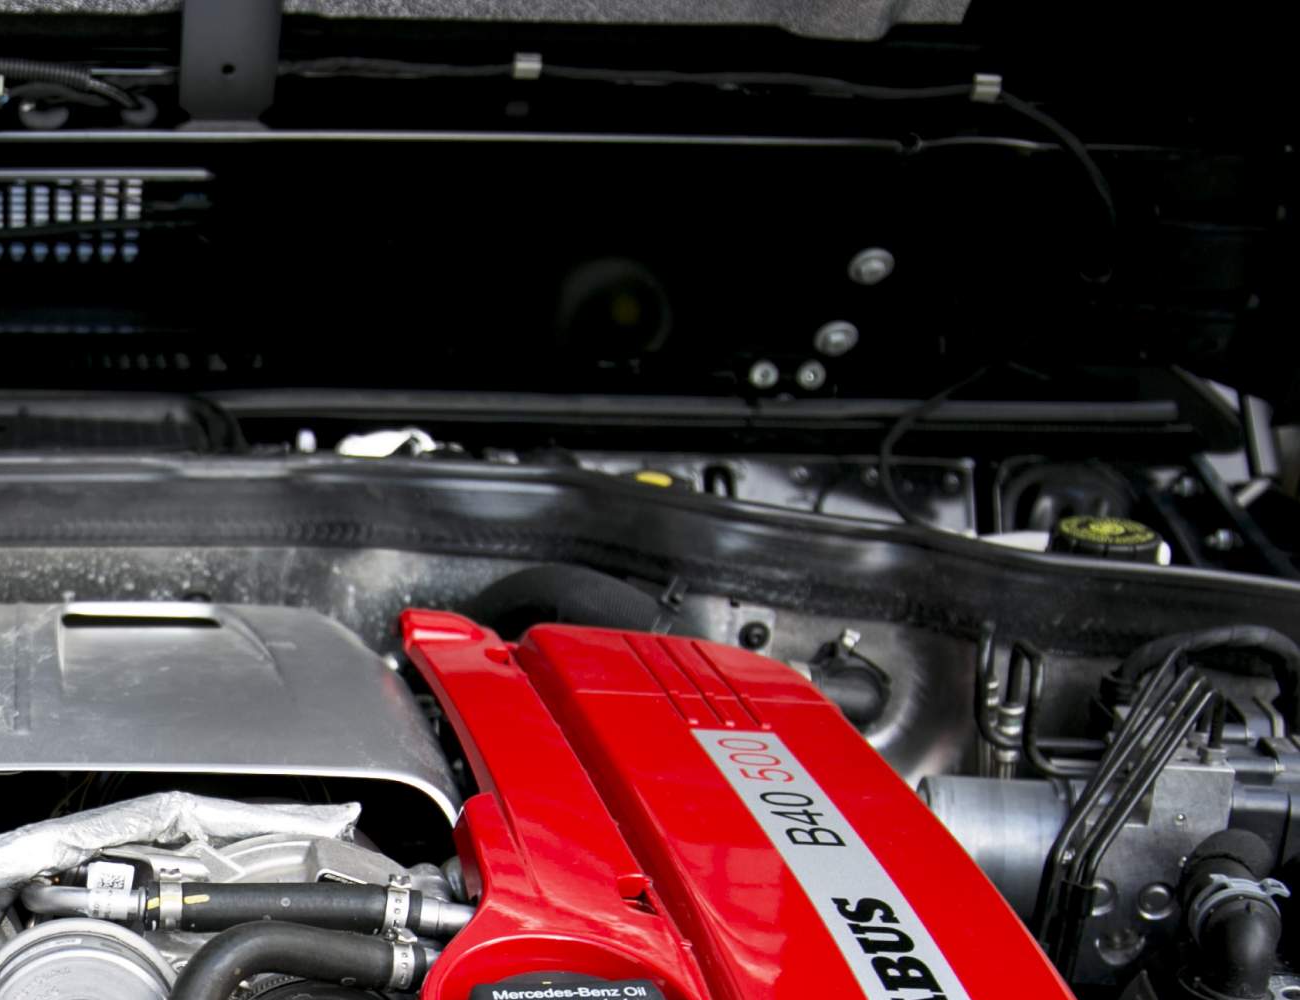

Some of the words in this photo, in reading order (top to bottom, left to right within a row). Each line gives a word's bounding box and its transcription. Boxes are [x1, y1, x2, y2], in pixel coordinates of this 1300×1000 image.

[717, 737, 795, 783] 500
[759, 791, 847, 847] B40
[492, 986, 621, 1000] Mercedes-Benz
[623, 986, 647, 997] Oil
